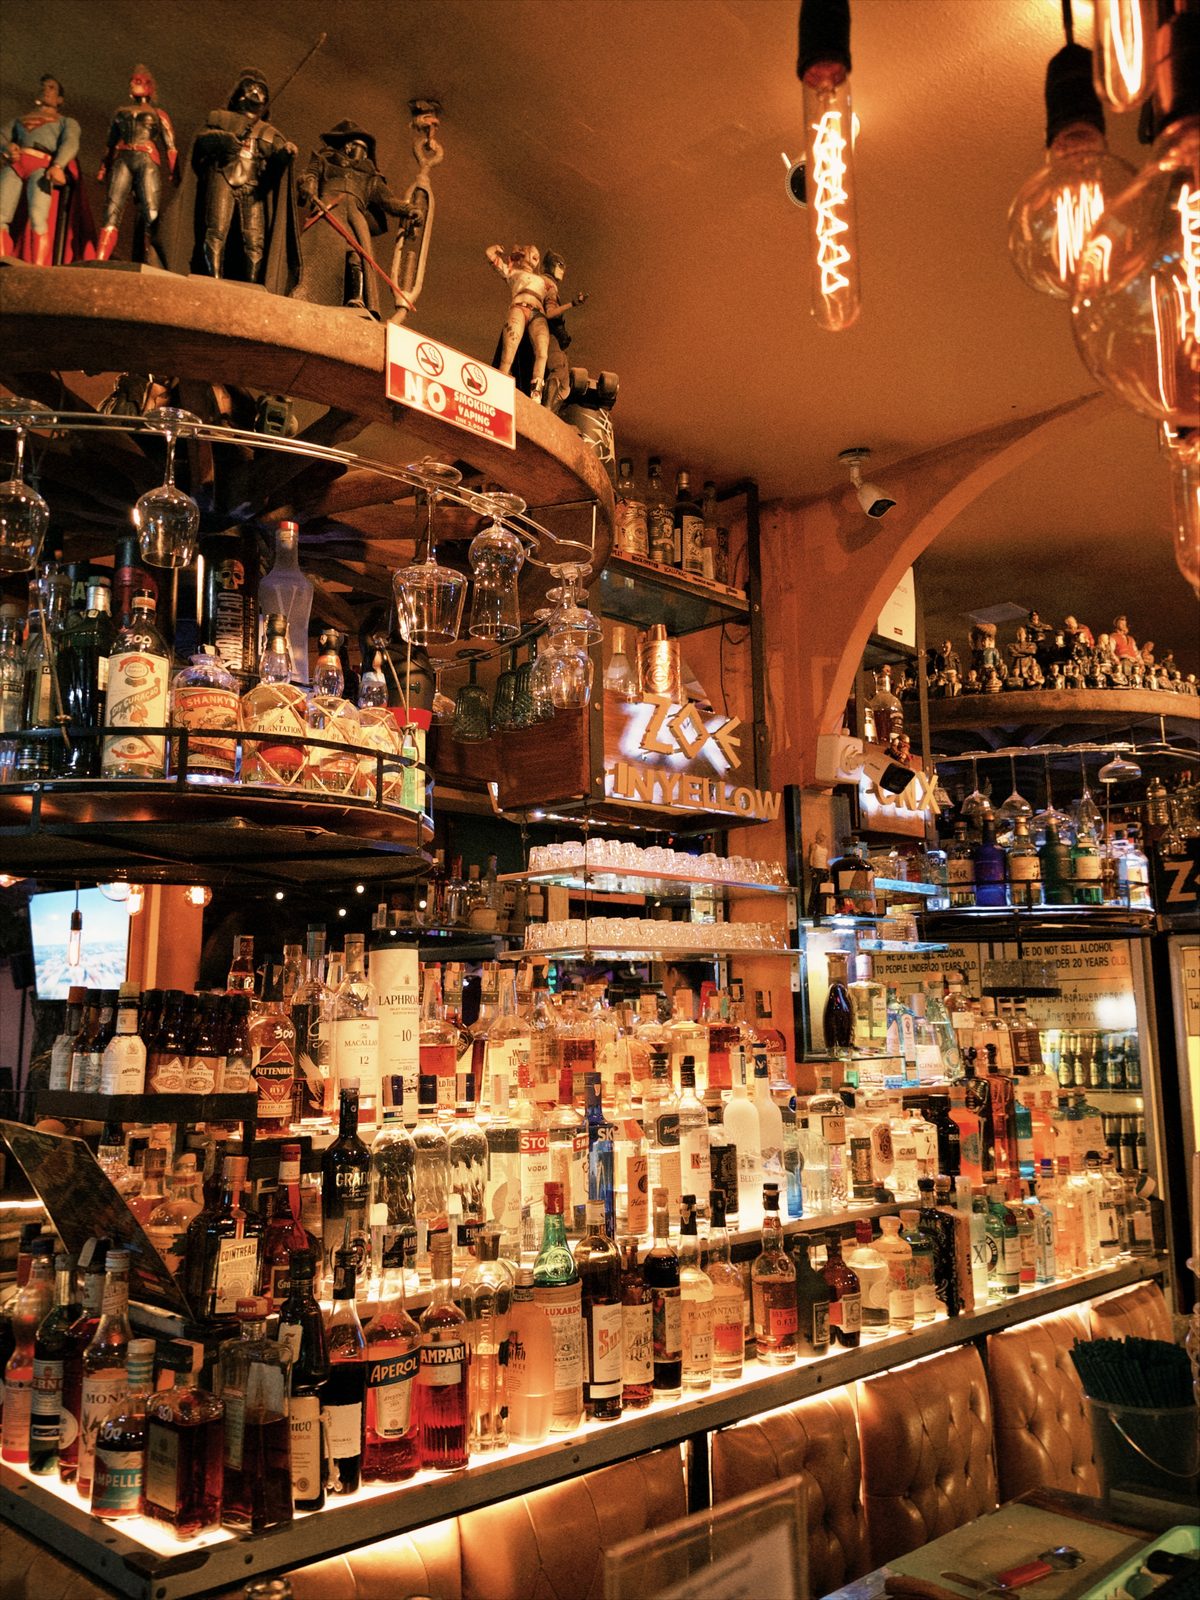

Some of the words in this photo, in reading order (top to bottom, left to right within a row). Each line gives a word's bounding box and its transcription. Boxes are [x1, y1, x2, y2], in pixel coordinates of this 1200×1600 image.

[404, 369, 447, 413] NO
[453, 390, 496, 417] SMOKING
[458, 404, 490, 427] VAPING
[215, 592, 243, 670] SMOKEHEAD
[124, 634, 152, 648] 300
[1032, 946, 1042, 956] DO
[1044, 945, 1058, 955] NOT
[1061, 944, 1077, 954] SELL
[1080, 942, 1114, 953] ALCOHOL
[876, 965, 884, 974] TO
[886, 964, 908, 974] PEOPLE
[909, 963, 929, 973] UNDER
[930, 962, 939, 972] 20
[941, 961, 960, 971] YEARS
[1055, 958, 1071, 969] DER
[1072, 958, 1082, 968] 20
[1085, 956, 1109, 967] YEARS
[378, 994, 418, 1006] LAPHRO
[274, 1029, 294, 1039] 300
[401, 1029, 412, 1042] 10
[359, 1055, 370, 1065] 12
[221, 1244, 256, 1262] COINTREAU
[545, 1305, 581, 1316] LUXARDO
[420, 1345, 465, 1364] AMPARI
[370, 1357, 418, 1383] APEROL
